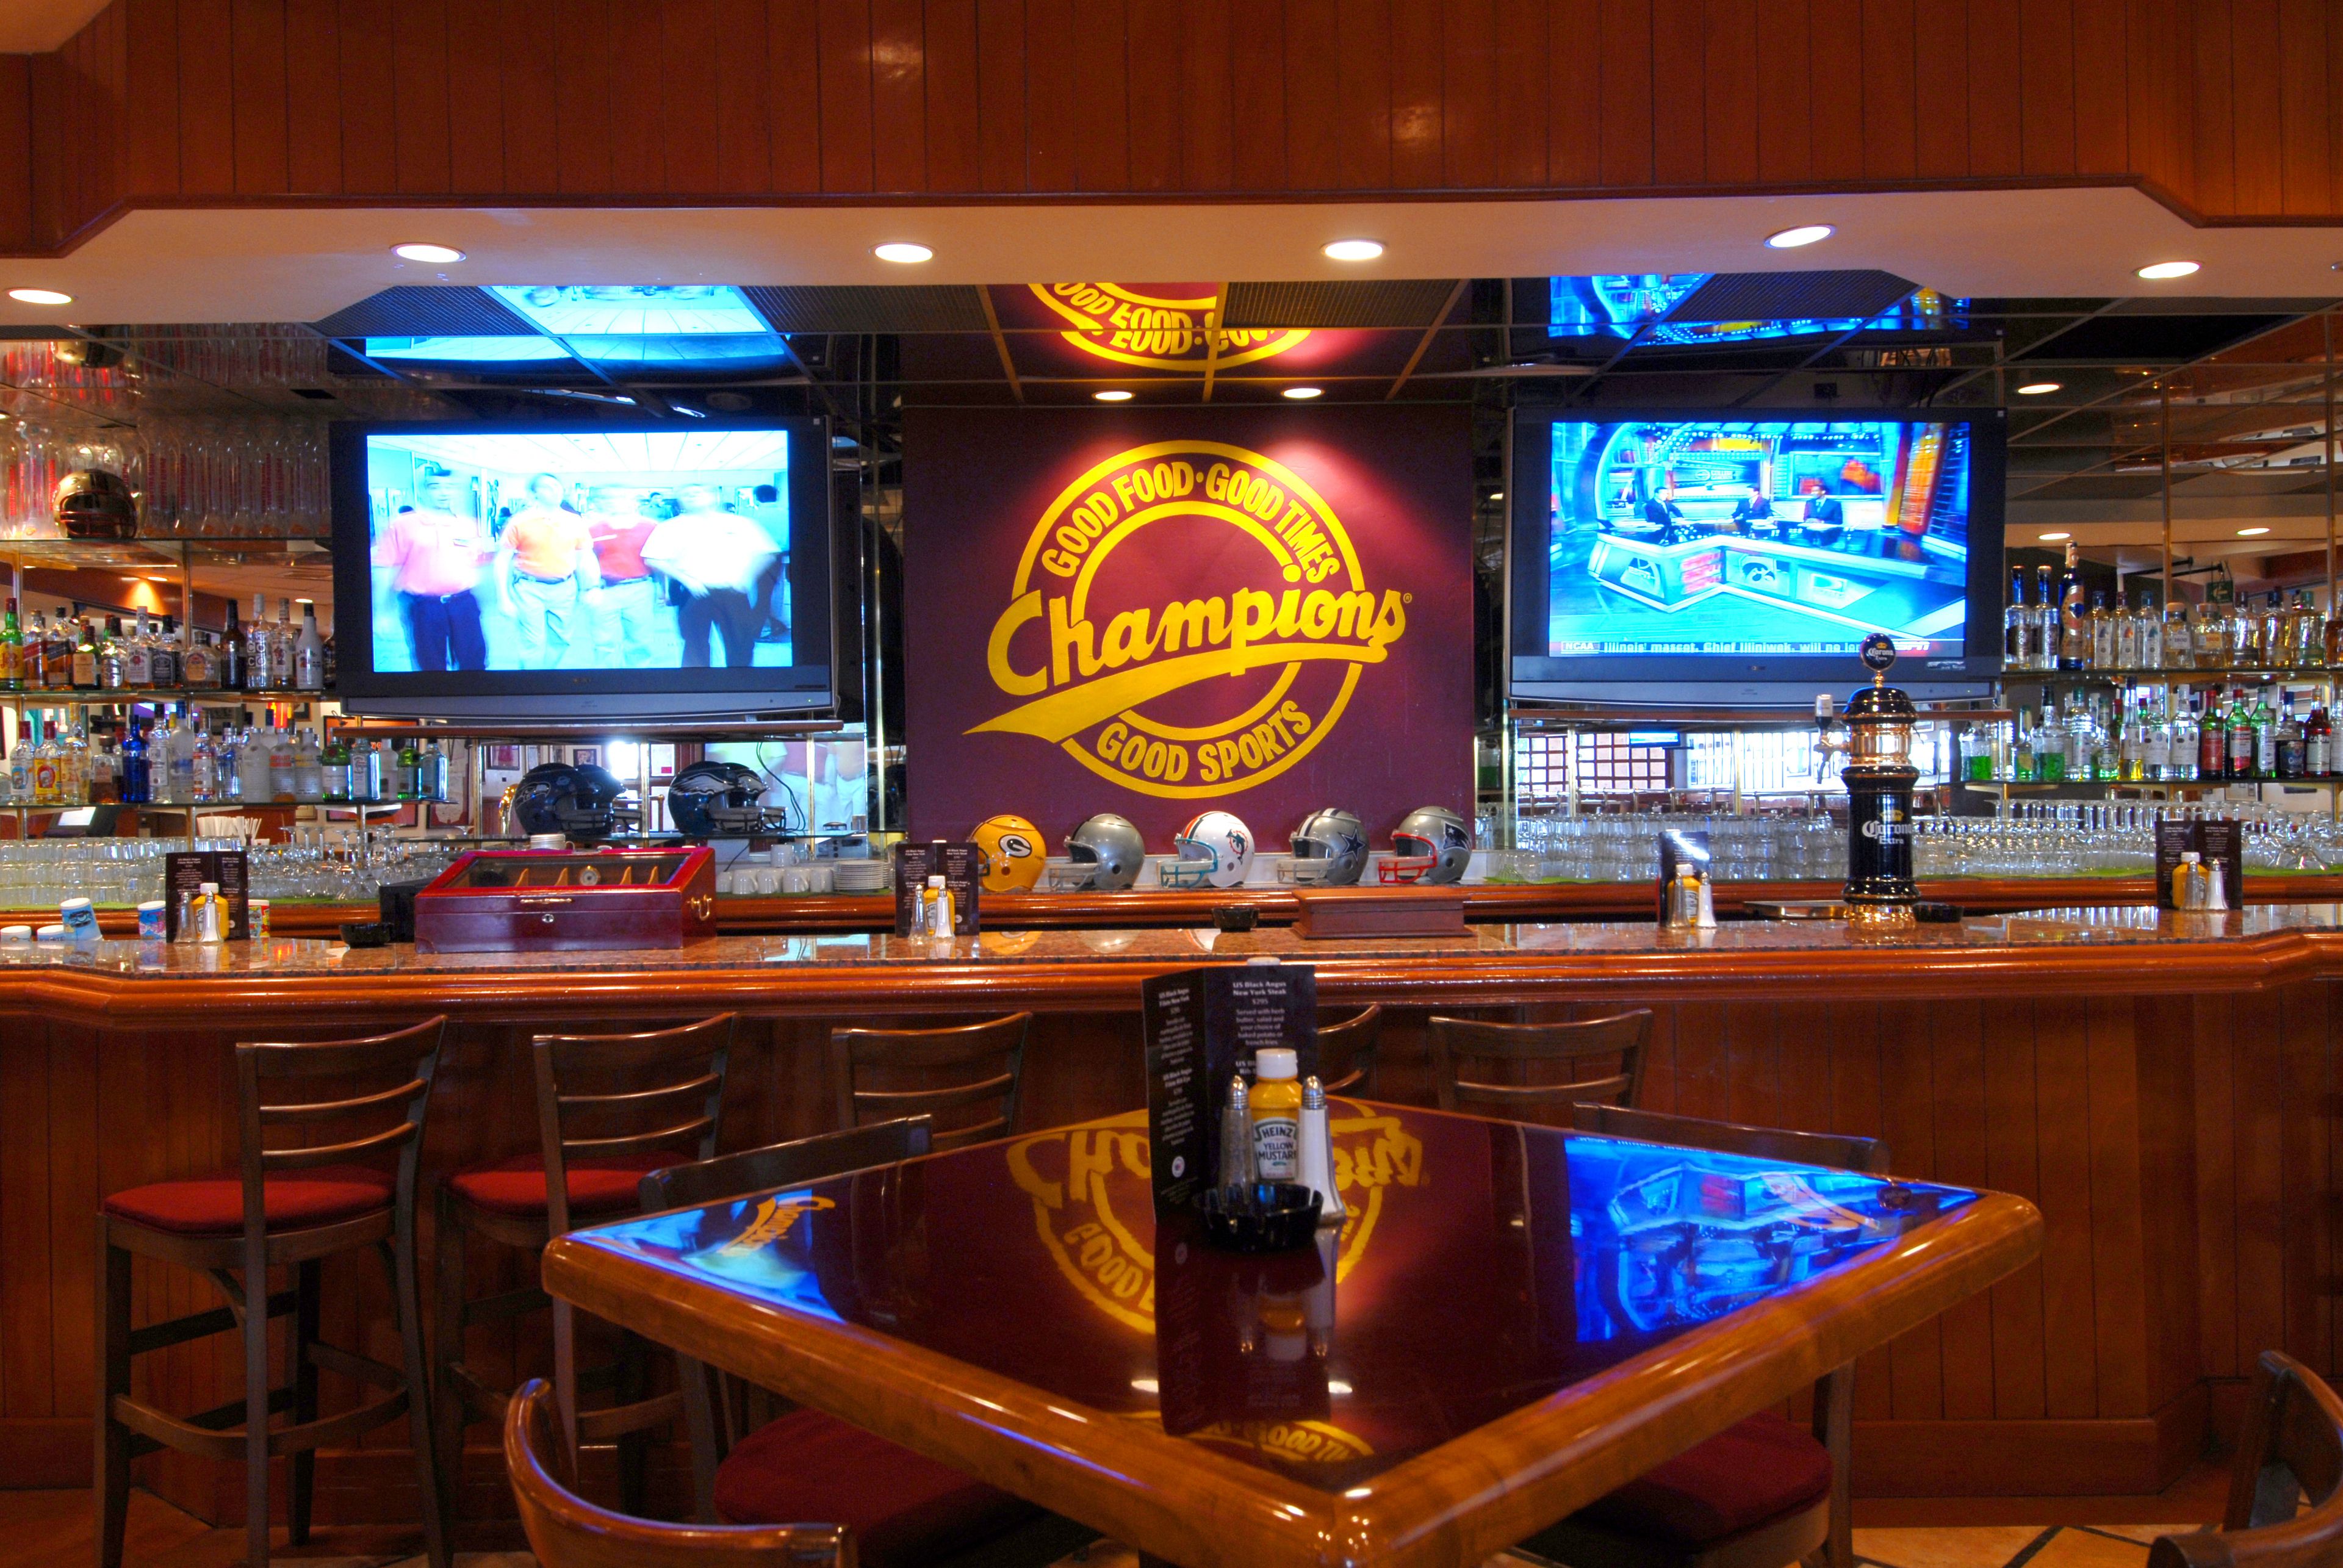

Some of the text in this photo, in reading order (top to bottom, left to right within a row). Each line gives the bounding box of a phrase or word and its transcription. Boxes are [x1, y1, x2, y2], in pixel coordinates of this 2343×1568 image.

[1042, 462, 1195, 578] GOOD FOOD
[1206, 462, 1341, 583] GOOD TIMES
[987, 563, 1406, 697] Champions
[1703, 642, 1737, 653] Chief
[1800, 642, 1821, 653] will
[1826, 643, 1841, 653] no
[1096, 700, 1311, 783] GOOD SPORTS
[1879, 836, 1904, 844] Extra
[1262, 1126, 1293, 1138] HEINZ
[1263, 1142, 1294, 1150] YELLOW
